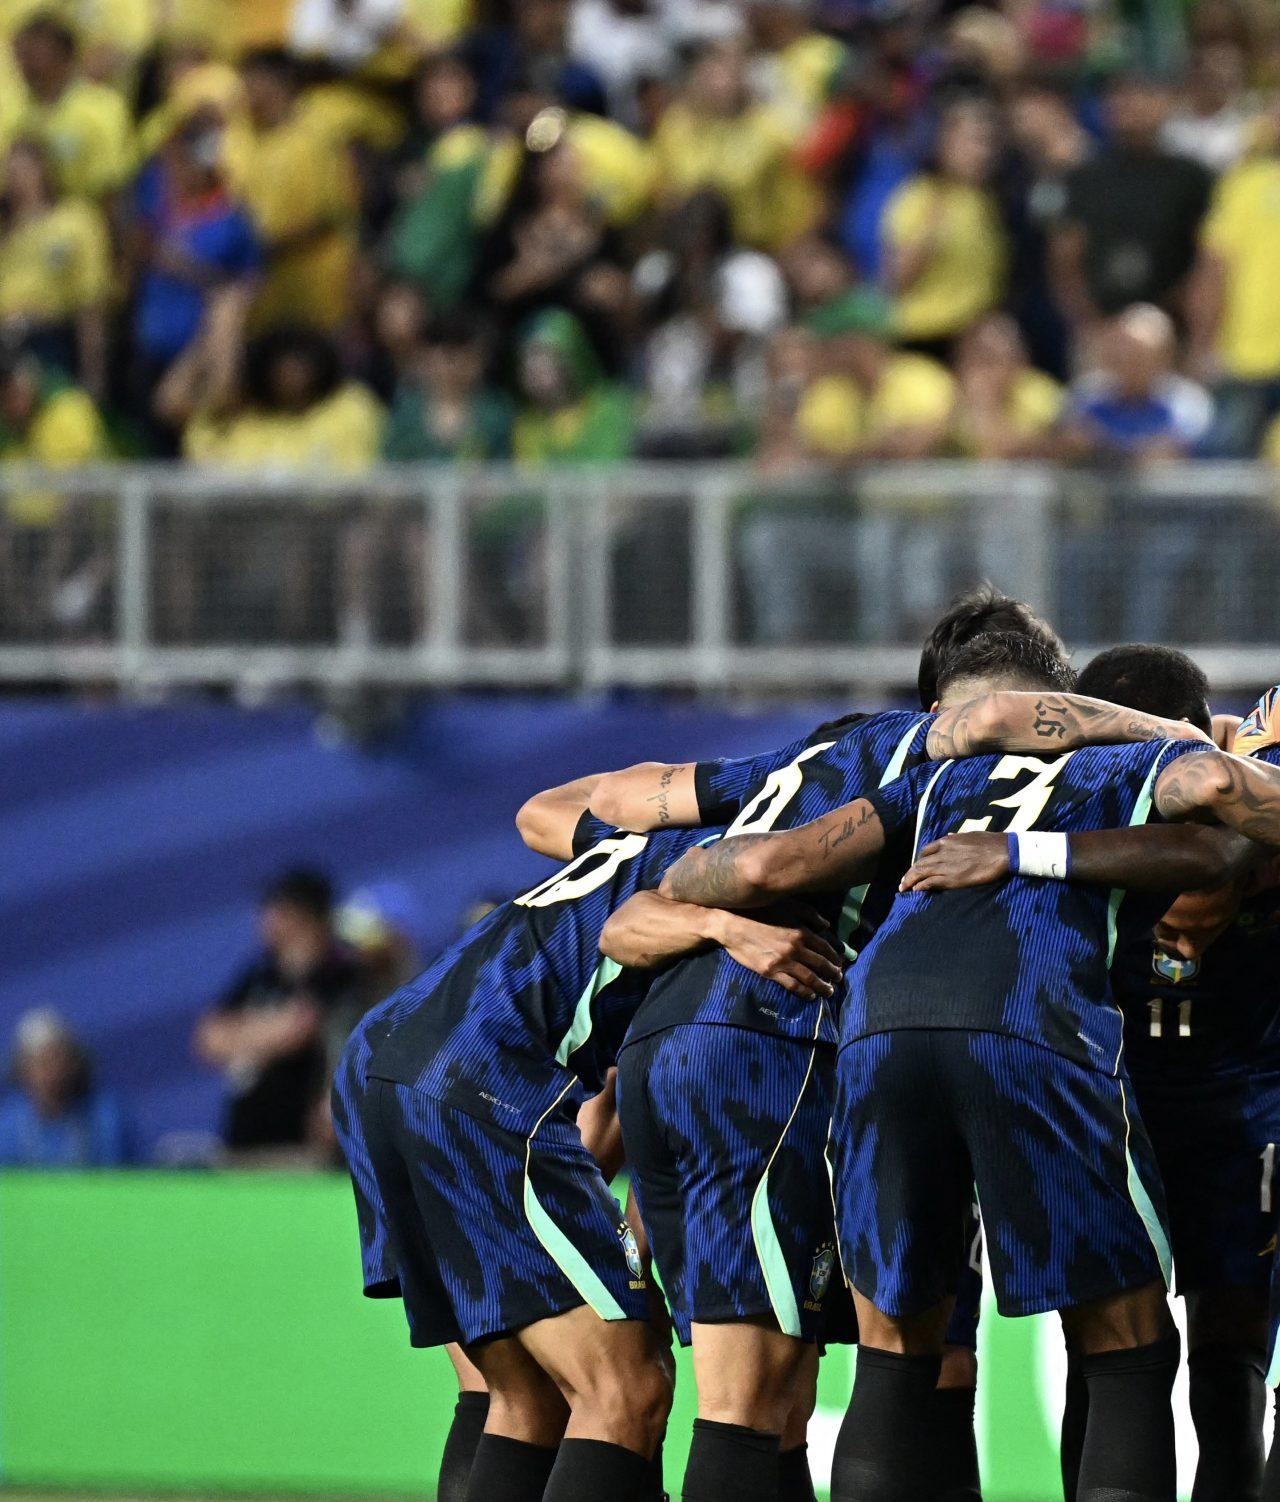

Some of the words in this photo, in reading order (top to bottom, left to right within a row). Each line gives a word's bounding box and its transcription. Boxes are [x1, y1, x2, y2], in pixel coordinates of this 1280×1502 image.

[1032, 700, 1068, 739] 97
[957, 750, 1077, 834] 3
[1147, 998, 1192, 1037] 11
